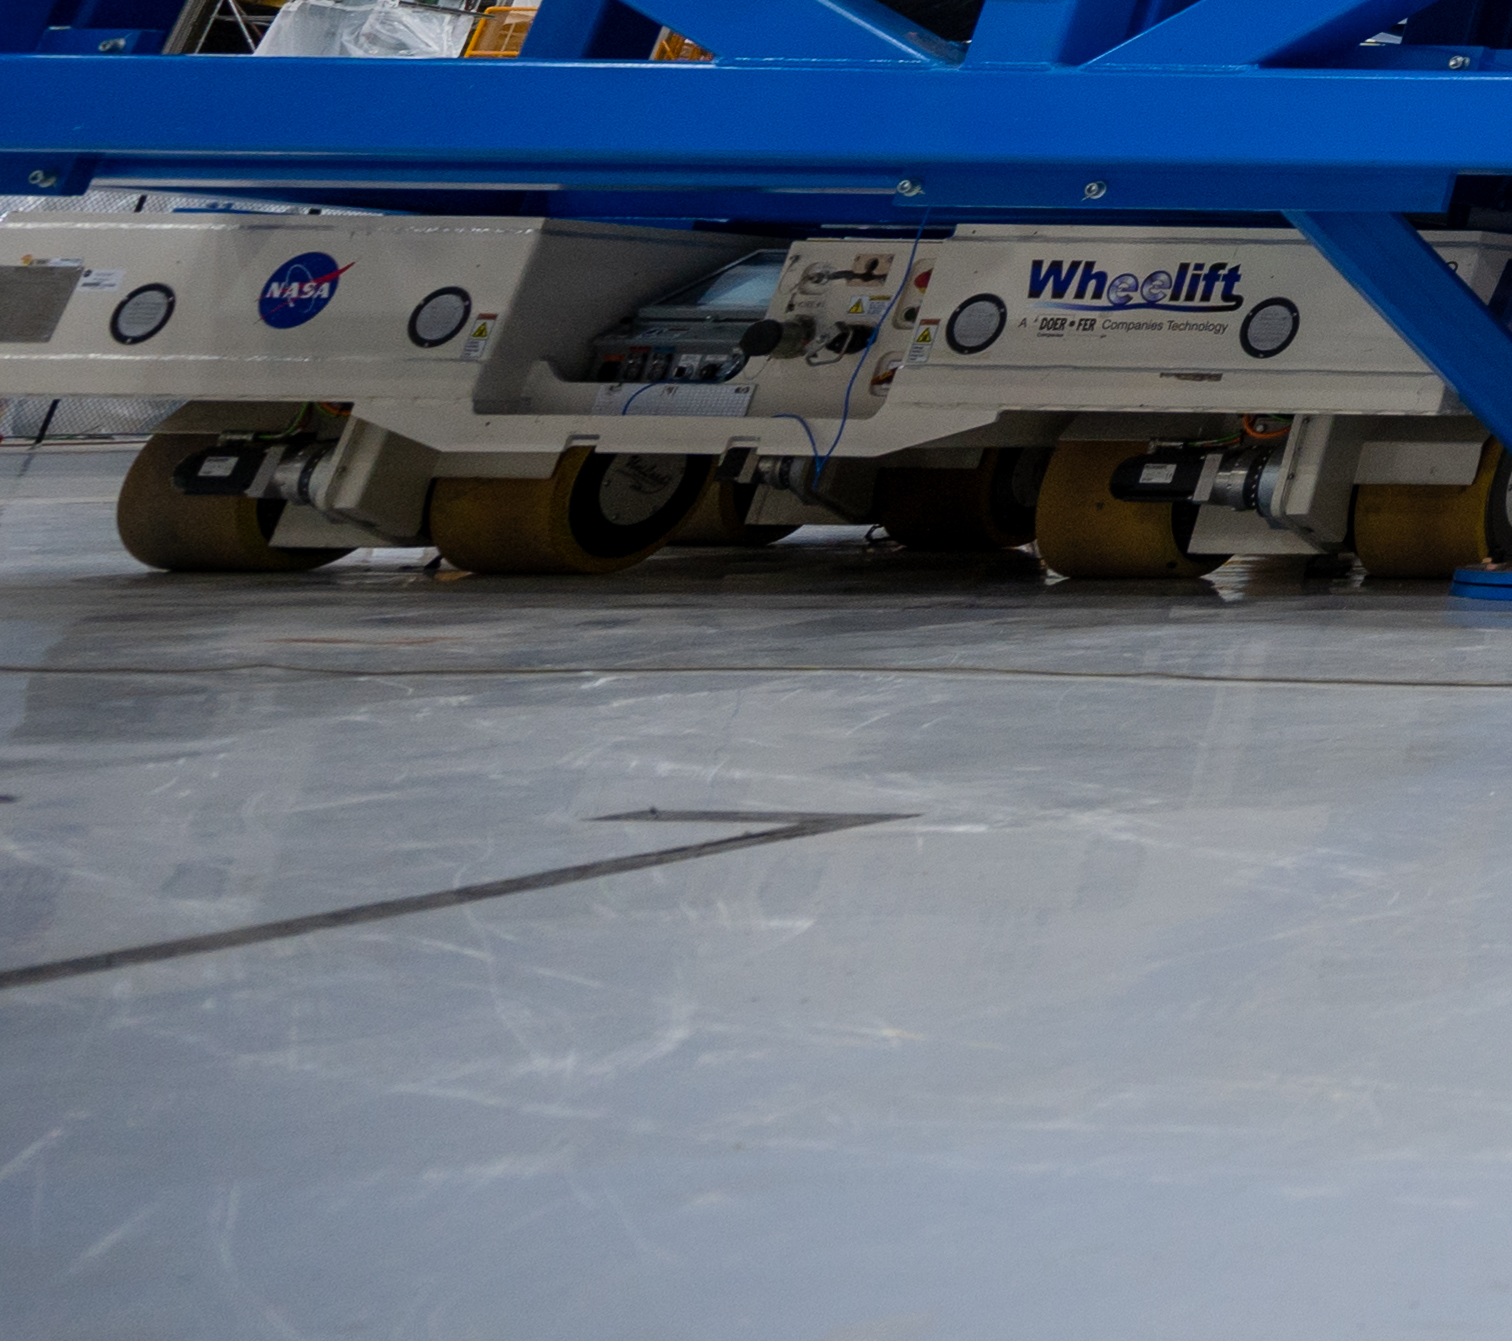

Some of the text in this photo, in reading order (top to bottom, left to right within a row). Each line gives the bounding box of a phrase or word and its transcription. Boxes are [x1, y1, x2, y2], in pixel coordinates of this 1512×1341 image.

[1027, 259, 1244, 307] Wheelift
[1102, 318, 1164, 333] Companies
[1168, 320, 1228, 335] Technology
